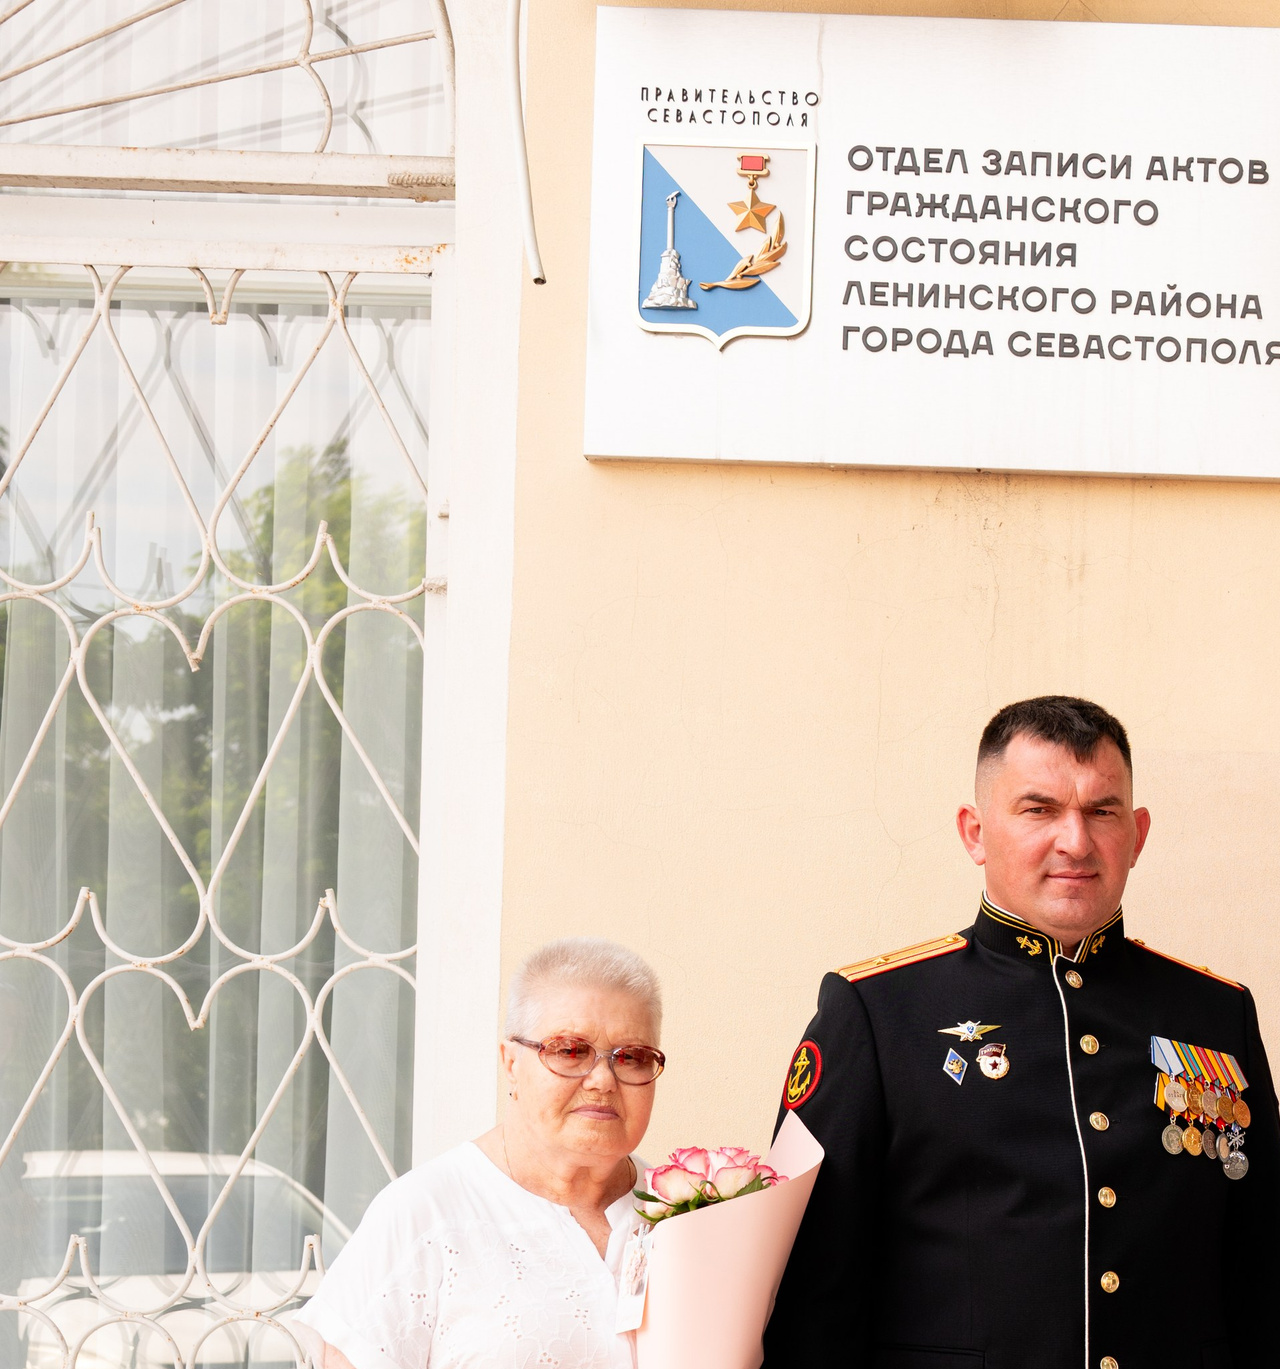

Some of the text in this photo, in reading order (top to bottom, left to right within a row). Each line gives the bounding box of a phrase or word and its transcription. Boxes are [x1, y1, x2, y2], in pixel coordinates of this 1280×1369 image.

[640, 85, 820, 108] ПРАВИТЕЛЬСТВО
[647, 107, 809, 128] СЕВАСТОПОЛЯ
[847, 145, 1271, 185] ОТДЕЛ ЗАПИСИ АКТОВ
[846, 190, 1160, 226] ГРАЖДАНСКОГО
[844, 234, 1077, 269] СОСТОЯНИЯ
[842, 280, 1264, 321] ЛЕНИНСКОГО РАЙОНА
[842, 325, 995, 359] ГОРОДА
